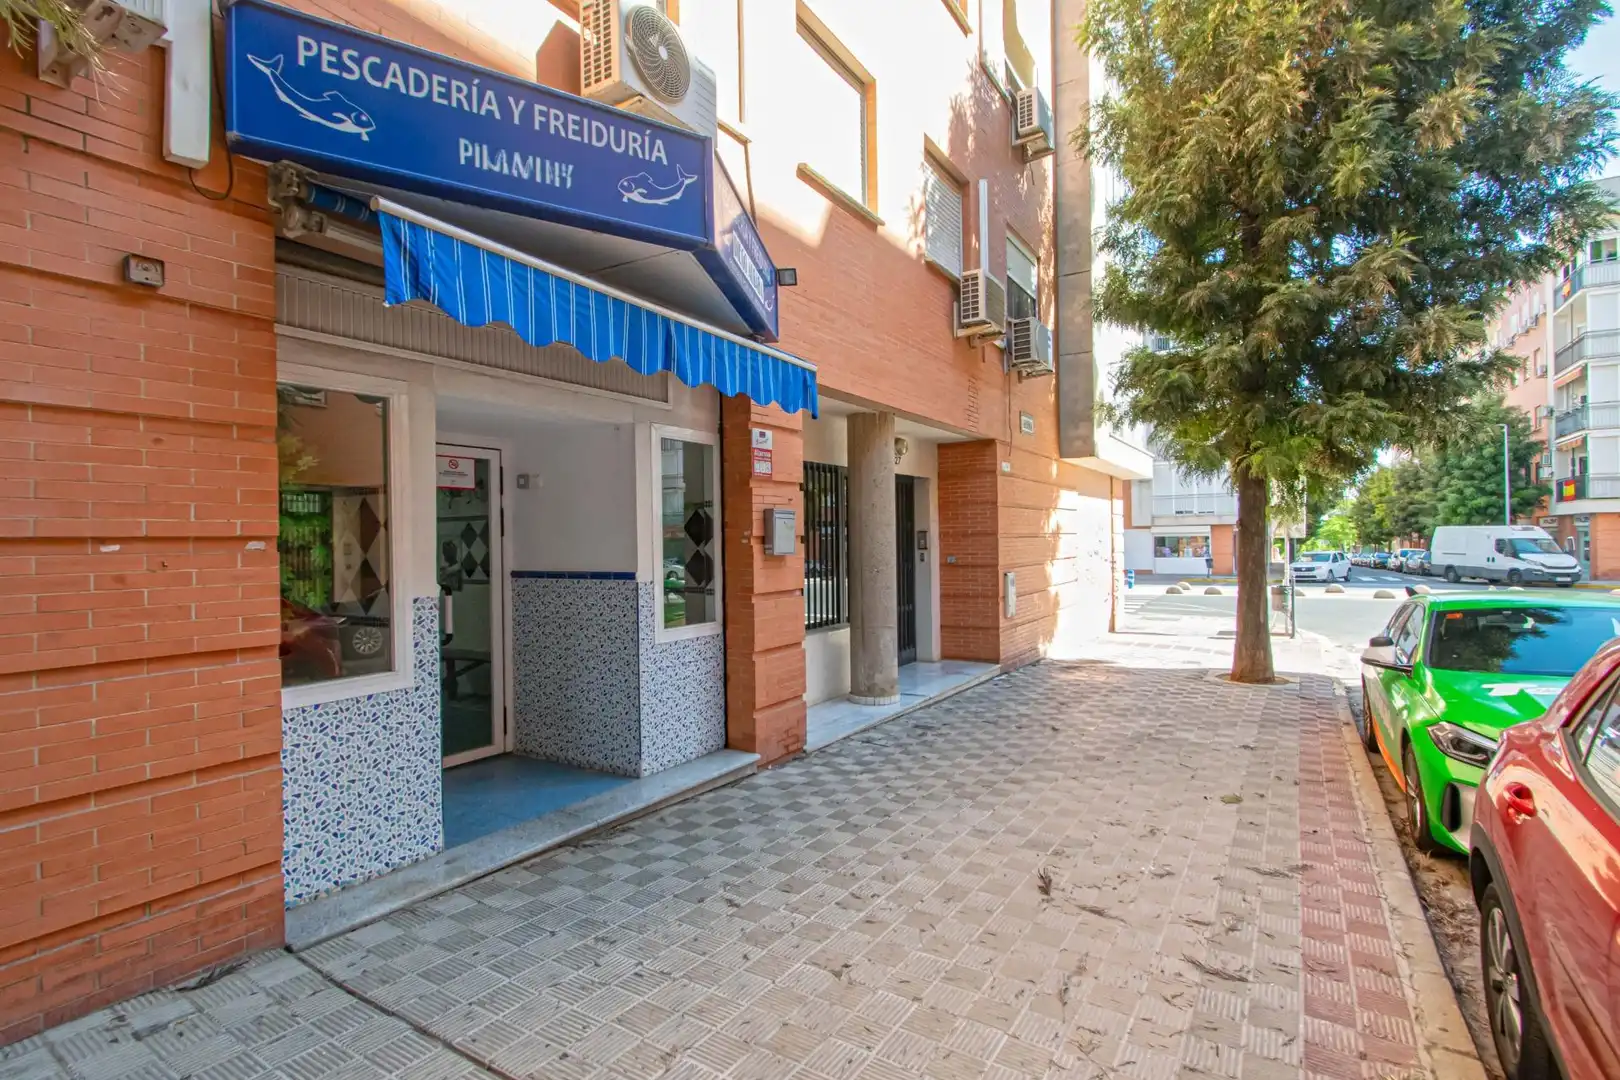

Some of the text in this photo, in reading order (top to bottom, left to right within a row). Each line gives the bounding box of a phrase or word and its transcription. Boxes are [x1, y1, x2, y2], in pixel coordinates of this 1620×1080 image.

[297, 35, 668, 166] PESCADERÍA Y FREIDURÍA
